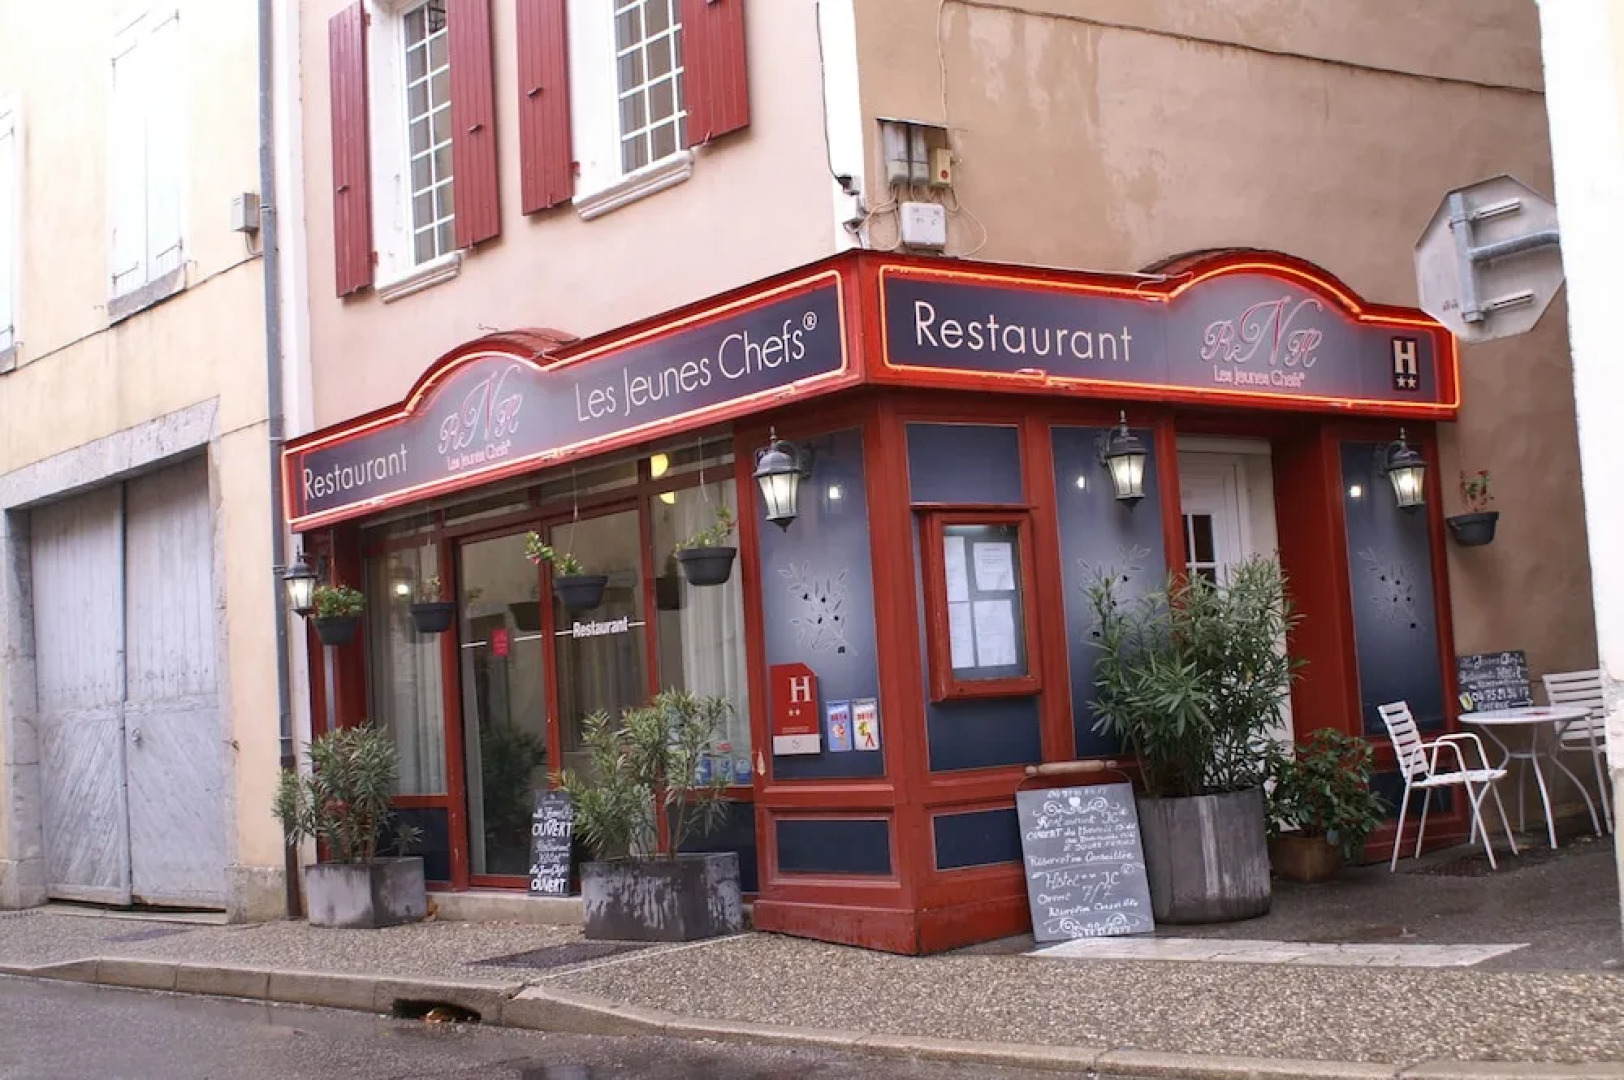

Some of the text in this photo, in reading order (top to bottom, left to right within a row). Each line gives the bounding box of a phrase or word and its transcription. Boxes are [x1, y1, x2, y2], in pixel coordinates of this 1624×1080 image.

[914, 299, 1133, 363] Restaurant
[1392, 339, 1418, 375] H
[1213, 365, 1231, 383] Les
[574, 382, 616, 423] Les
[622, 357, 713, 417] Jeunes
[302, 443, 407, 501] Restaurant
[572, 616, 629, 638] Restaurant
[789, 675, 812, 702] H
[532, 819, 572, 837] OUVERT
[531, 877, 566, 893] OUVERT
